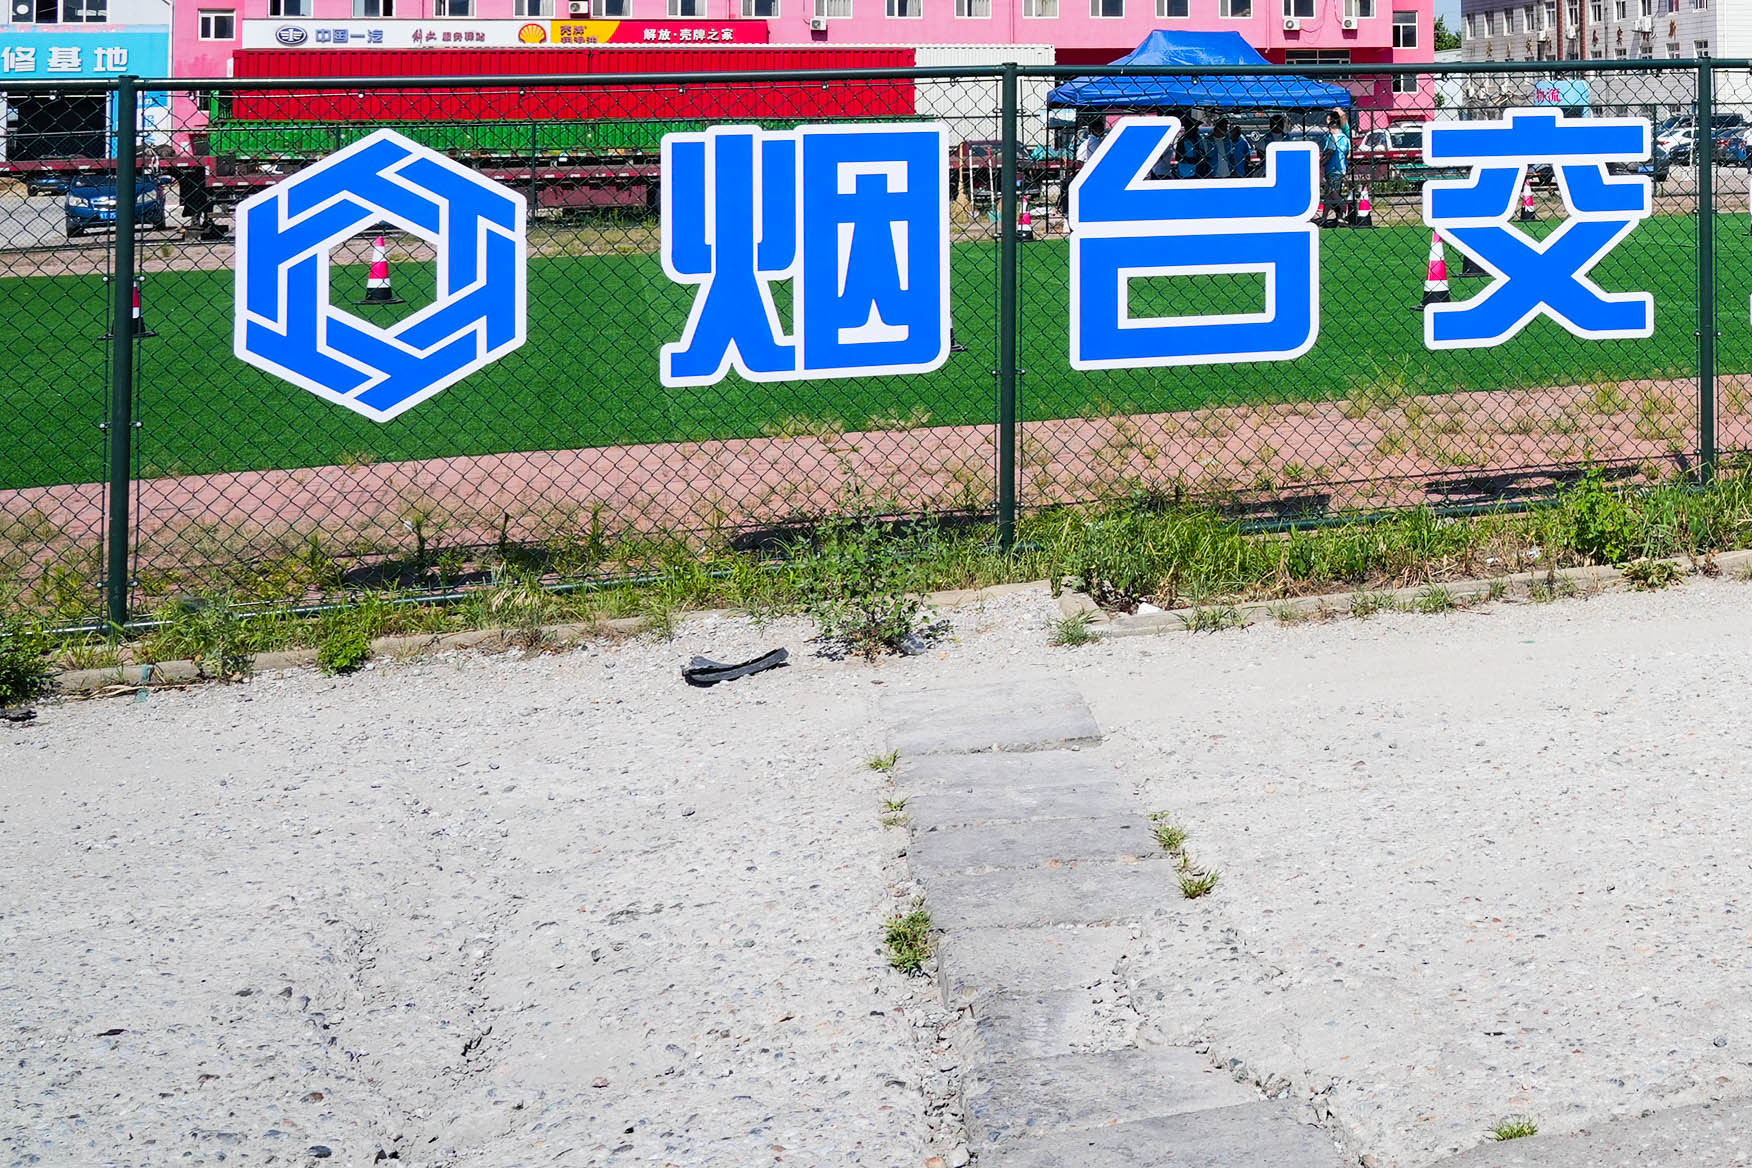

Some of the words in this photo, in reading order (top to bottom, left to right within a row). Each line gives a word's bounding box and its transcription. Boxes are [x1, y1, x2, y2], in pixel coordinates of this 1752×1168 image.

[315, 29, 384, 44] 中国一汽
[1, 46, 129, 73] 修基地
